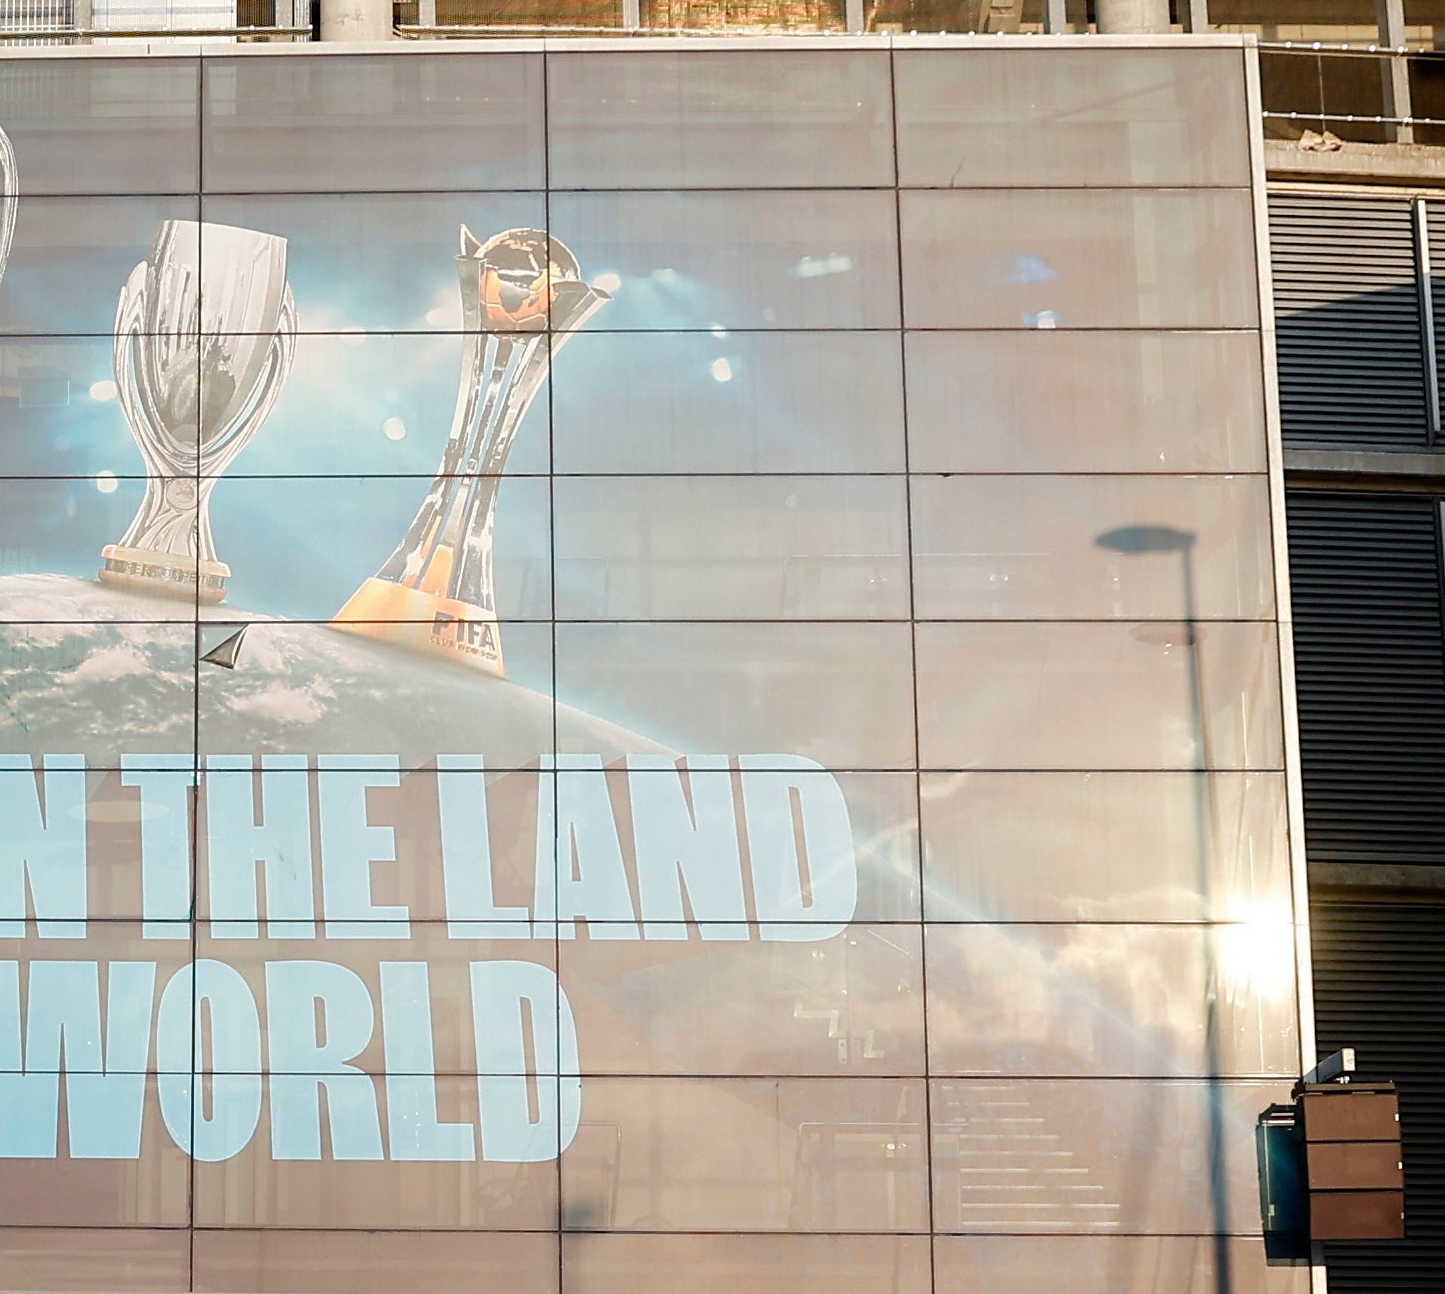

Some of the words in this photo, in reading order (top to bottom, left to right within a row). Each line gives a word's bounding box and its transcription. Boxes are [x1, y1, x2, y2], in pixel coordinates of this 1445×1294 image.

[433, 611, 495, 650] FIFA
[118, 753, 398, 941] THE
[436, 752, 860, 944] LAND
